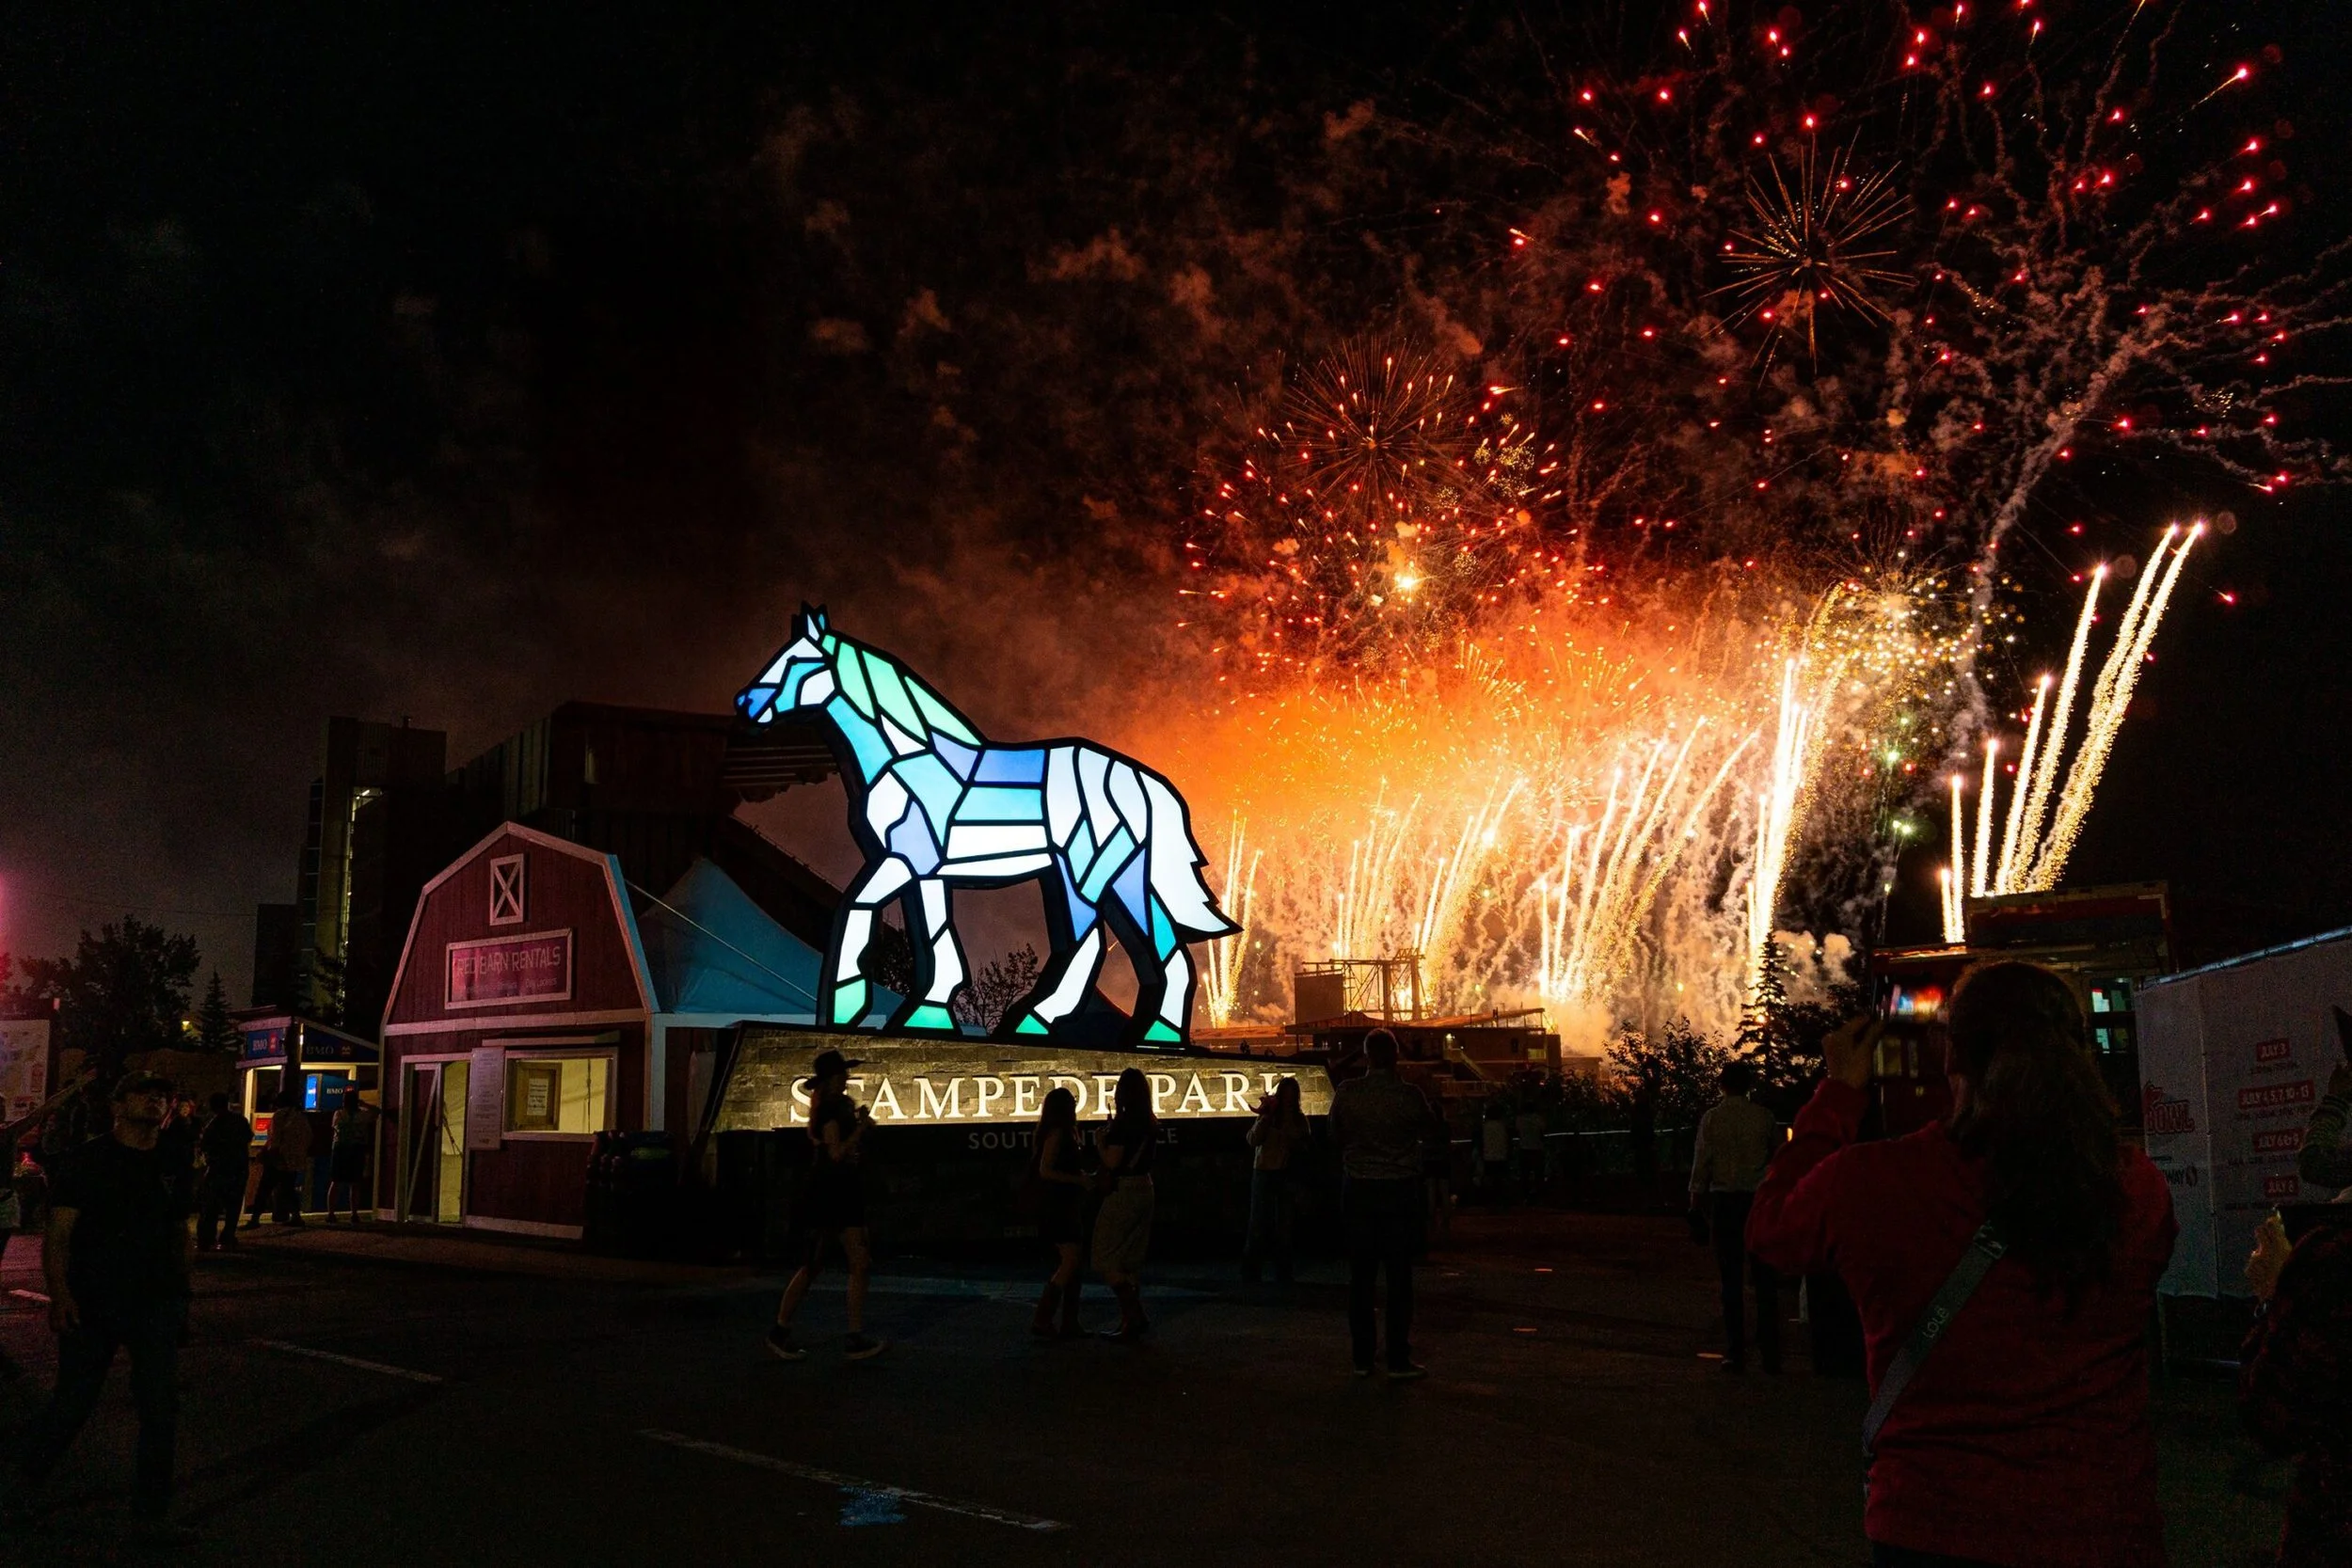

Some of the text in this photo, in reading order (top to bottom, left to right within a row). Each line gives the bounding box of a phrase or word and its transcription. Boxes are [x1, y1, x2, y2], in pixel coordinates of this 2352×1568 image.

[457, 945, 561, 976] RED BARN RENTALS
[790, 1075, 1121, 1123] SAMPEDE
[967, 1130, 1033, 1149] SOUT
